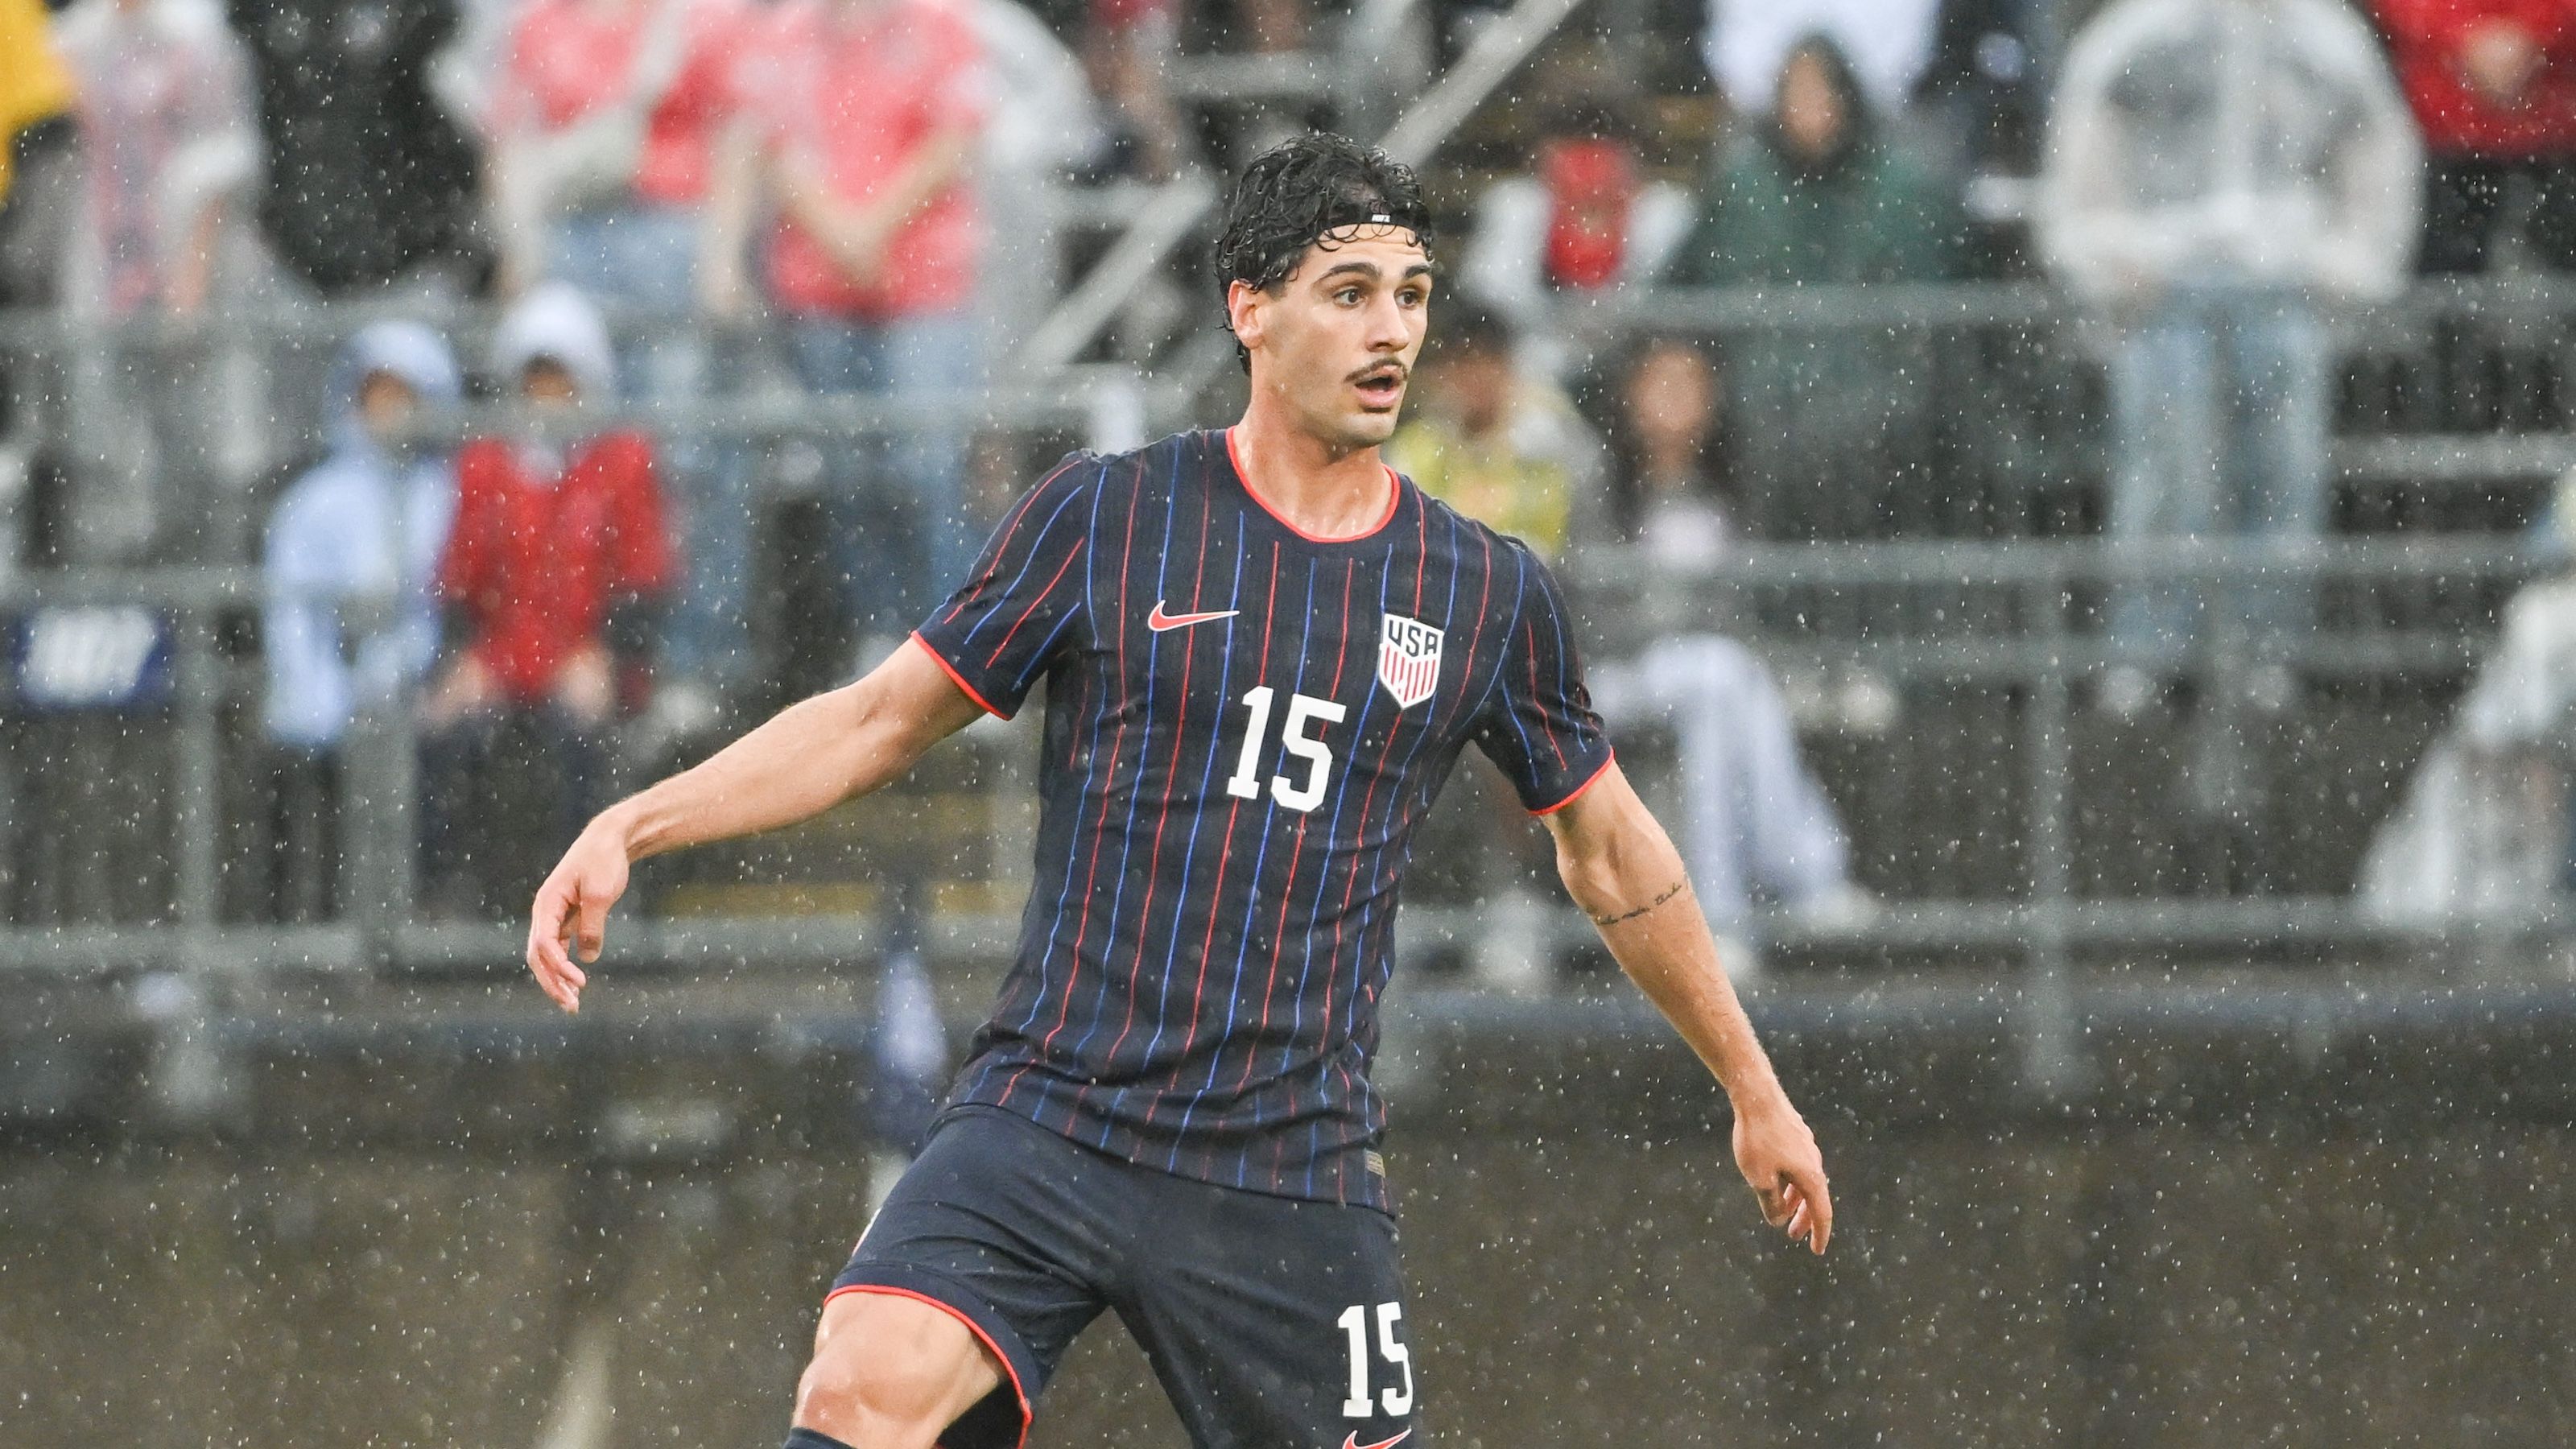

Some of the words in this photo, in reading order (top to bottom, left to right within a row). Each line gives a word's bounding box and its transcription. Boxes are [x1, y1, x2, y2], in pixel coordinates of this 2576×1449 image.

[1388, 619, 1439, 657] USA
[1226, 685, 1347, 812] 15
[1337, 1301, 1414, 1418] 15
